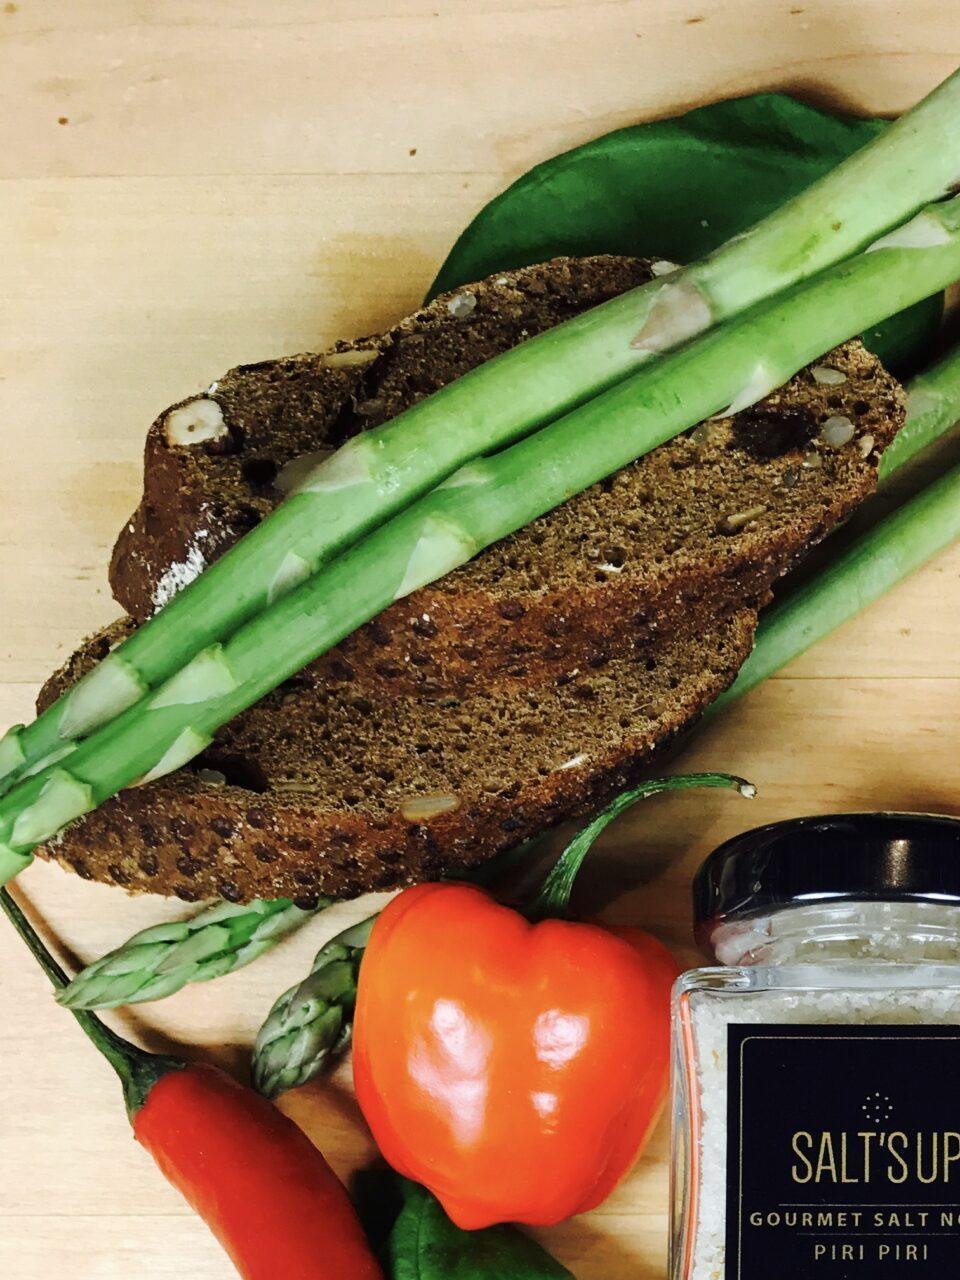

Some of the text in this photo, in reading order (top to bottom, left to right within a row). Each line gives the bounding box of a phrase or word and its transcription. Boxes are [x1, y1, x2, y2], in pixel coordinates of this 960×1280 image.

[791, 1131, 909, 1184] SALT'S
[750, 1212, 863, 1227] GOURMET
[873, 1212, 930, 1227] SALT
[814, 1244, 929, 1260] PIRI PIRI
